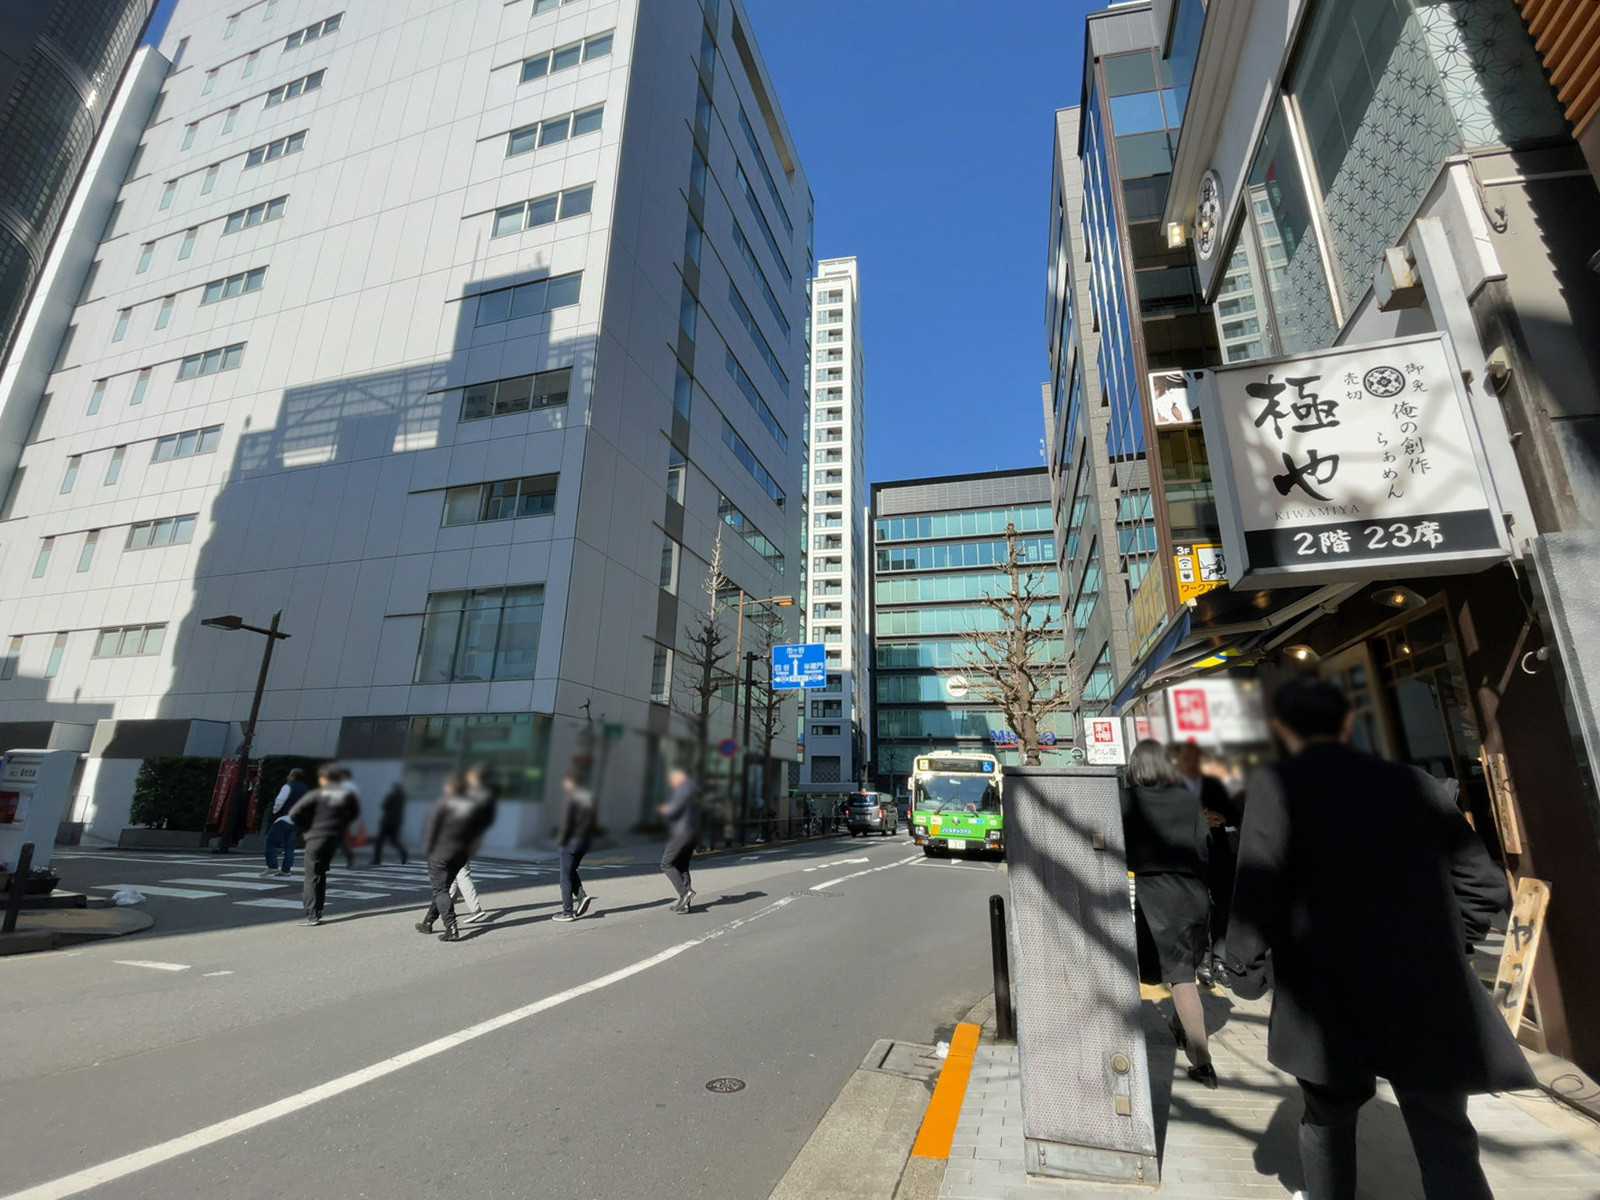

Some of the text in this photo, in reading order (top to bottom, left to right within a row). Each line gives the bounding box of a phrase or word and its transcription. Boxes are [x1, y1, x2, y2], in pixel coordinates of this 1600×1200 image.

[1343, 371, 1363, 400] 売切
[1404, 362, 1429, 393] 御免
[1245, 373, 1341, 501] 極や
[1391, 400, 1432, 476] 俺の創作
[1273, 503, 1361, 522] KIWAMIYA
[1176, 546, 1191, 555] 3F
[1293, 520, 1445, 556] 2階 23席
